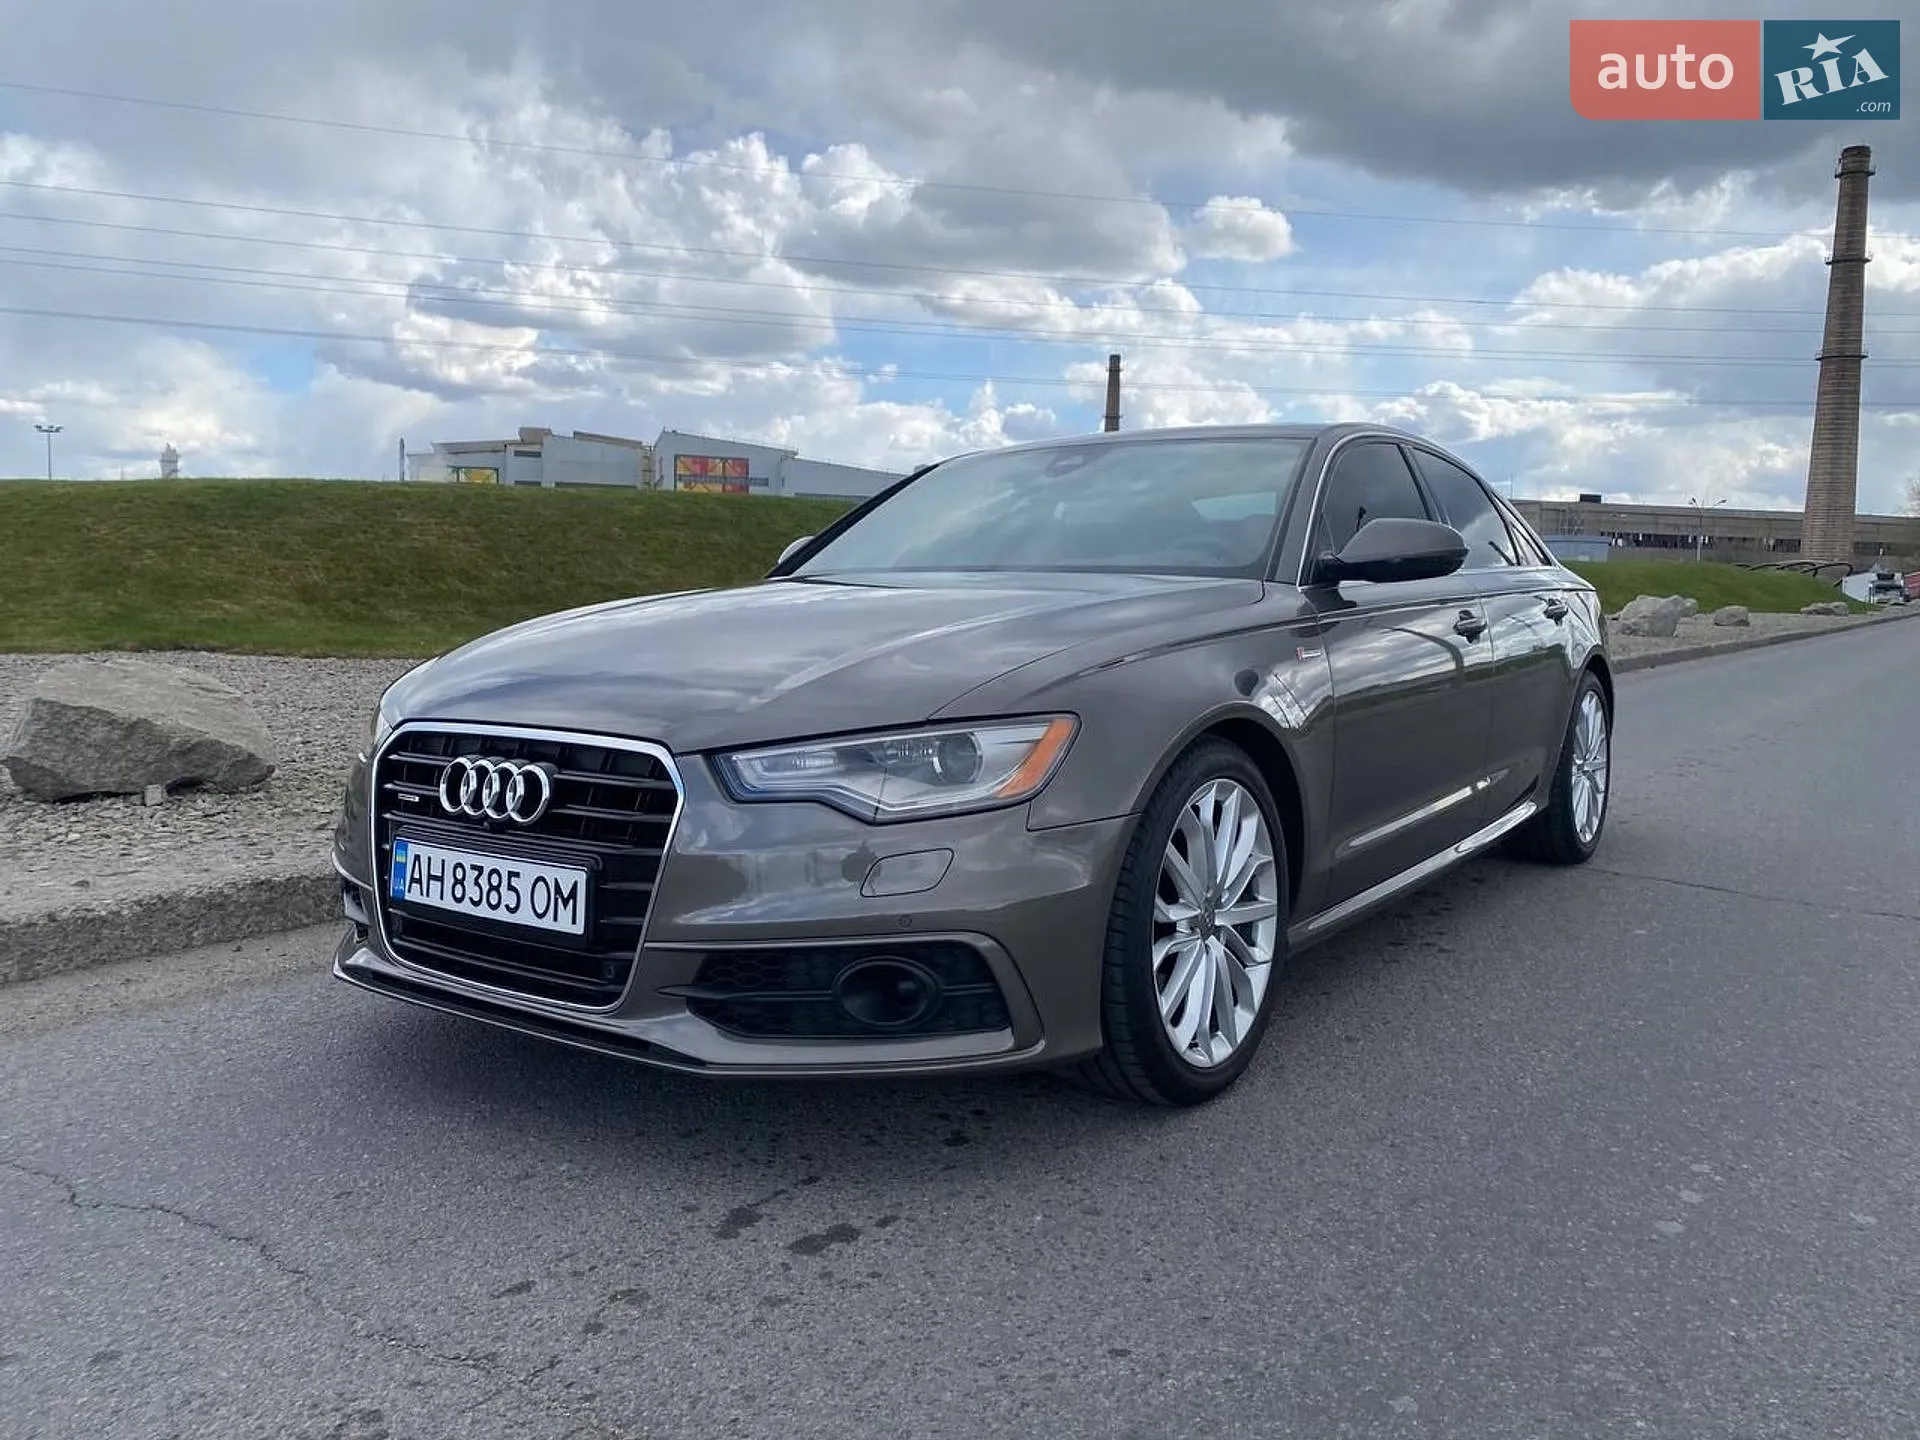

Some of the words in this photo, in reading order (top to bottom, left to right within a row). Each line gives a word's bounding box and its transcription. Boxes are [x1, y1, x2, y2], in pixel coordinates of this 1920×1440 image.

[407, 854, 445, 900] AH
[451, 862, 521, 914] 8385
[530, 875, 578, 925] OM
